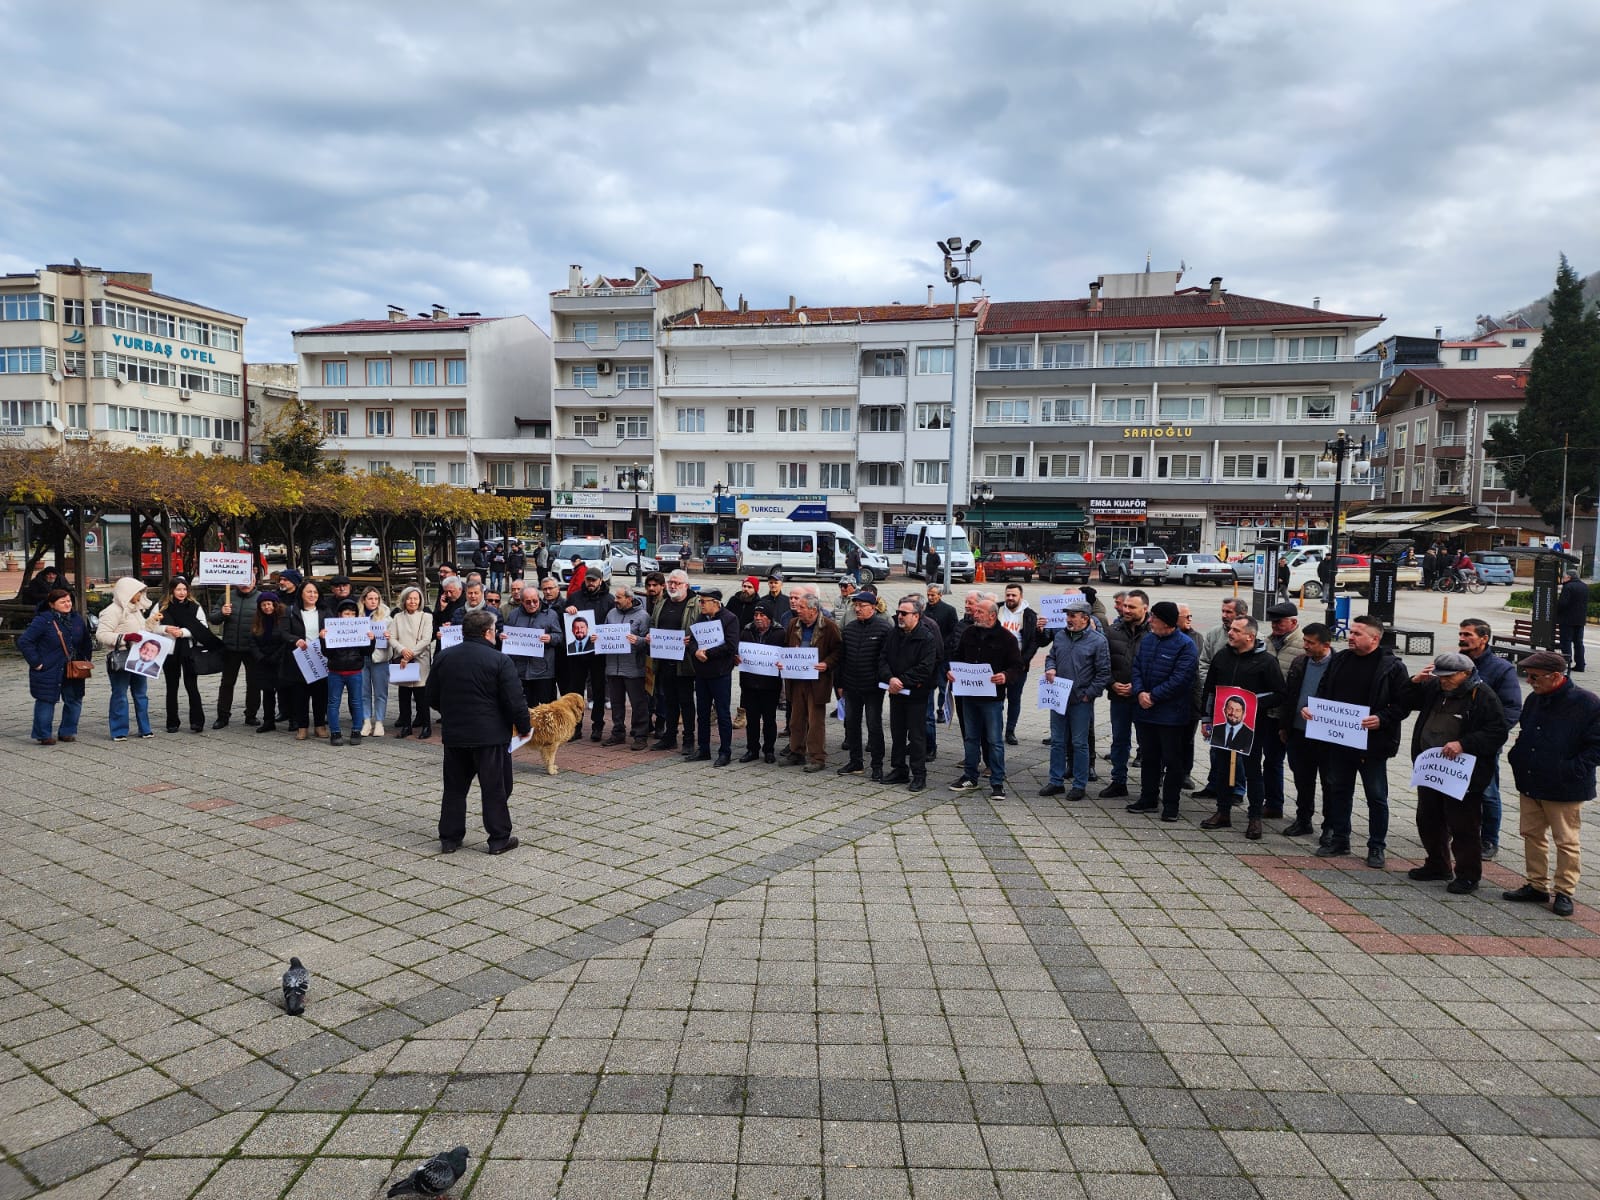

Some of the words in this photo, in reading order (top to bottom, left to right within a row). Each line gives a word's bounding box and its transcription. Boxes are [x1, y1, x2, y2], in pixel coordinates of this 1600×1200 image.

[112, 333, 173, 359] YURBAŞ
[180, 347, 216, 365] OTEL
[1123, 426, 1192, 438] SARIOĞLU
[1113, 498, 1146, 507] KUAFÖR
[894, 513, 947, 521] AYANCI
[960, 679, 984, 687] HAYIR
[1316, 703, 1361, 718] HUKUKSUZ
[1328, 729, 1345, 739] SON
[1424, 774, 1444, 785] SON
